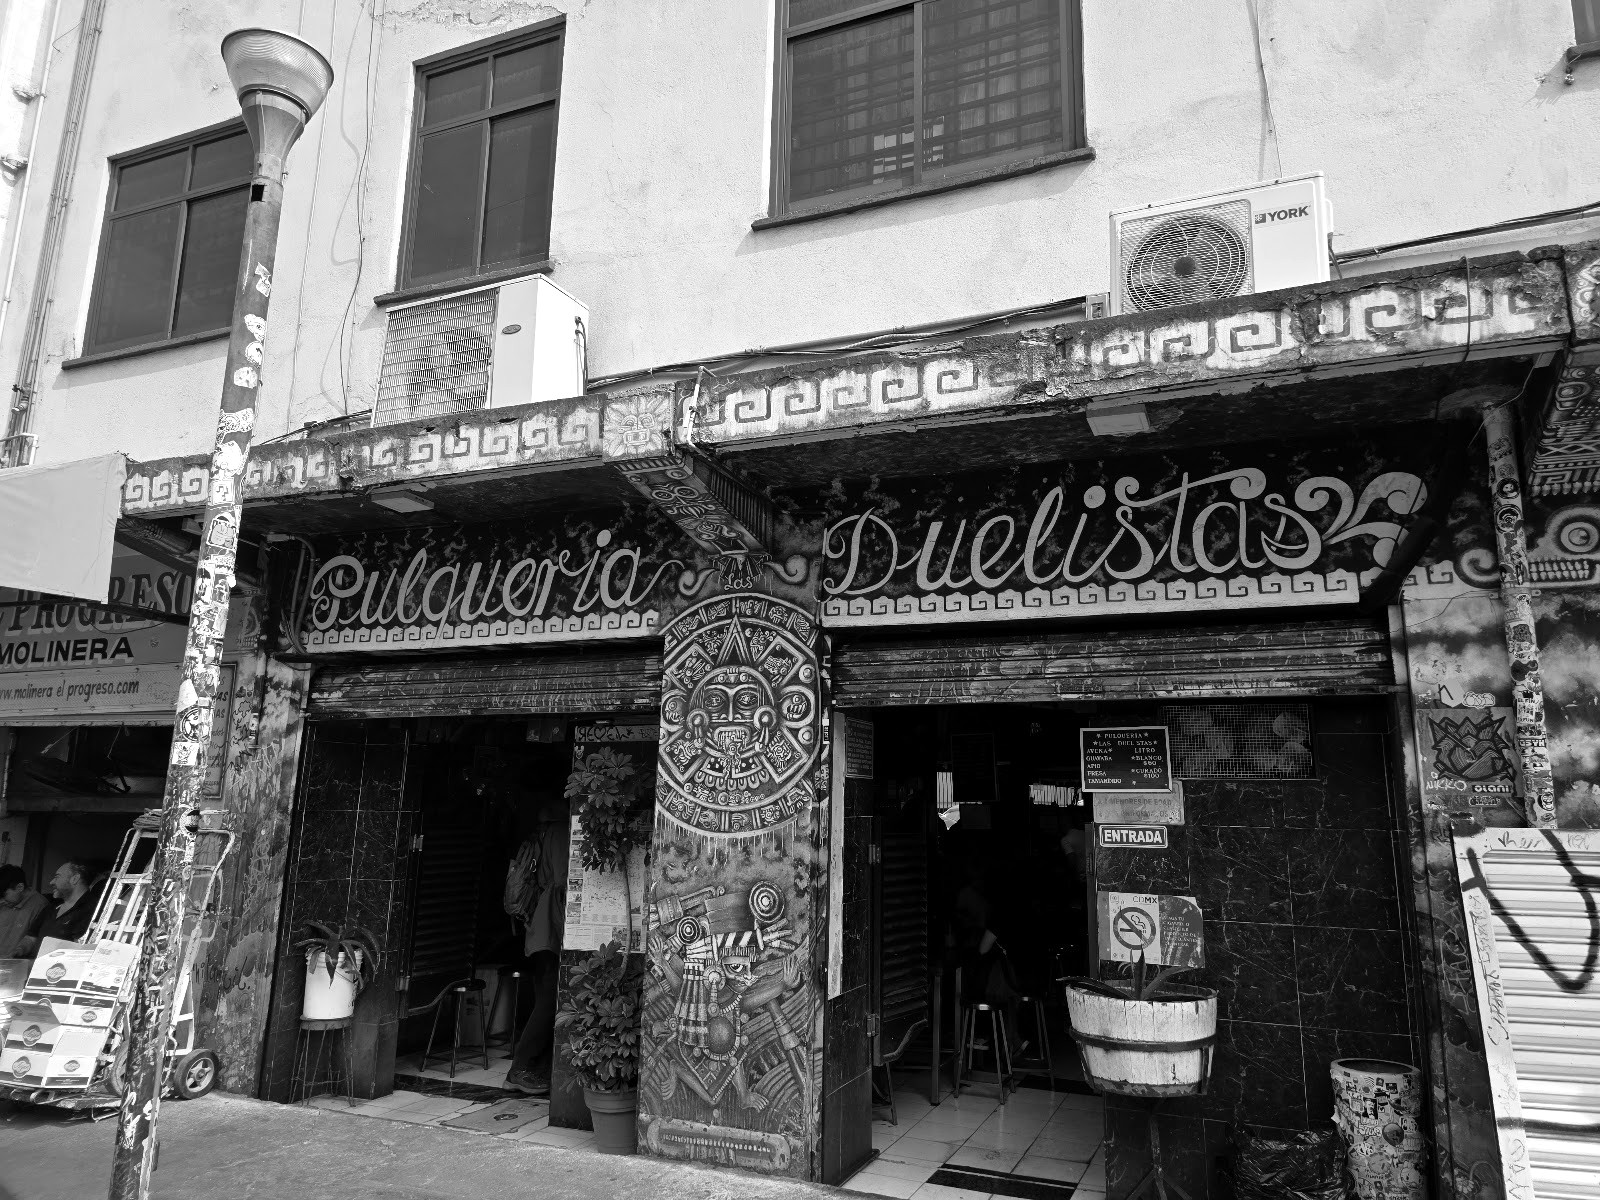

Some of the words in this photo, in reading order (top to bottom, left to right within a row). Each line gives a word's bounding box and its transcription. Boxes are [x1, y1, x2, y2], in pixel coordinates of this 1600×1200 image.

[1267, 206, 1309, 222] YORK
[823, 467, 1323, 596] Duelistas
[310, 529, 645, 637] Pulqueria
[724, 573, 753, 591] Las
[0, 637, 134, 665] MOLINERA
[56, 680, 66, 697] el
[67, 680, 140, 703] progreso.com
[1104, 829, 1163, 844] ENTRADA
[1132, 895, 1158, 904] CDMX
